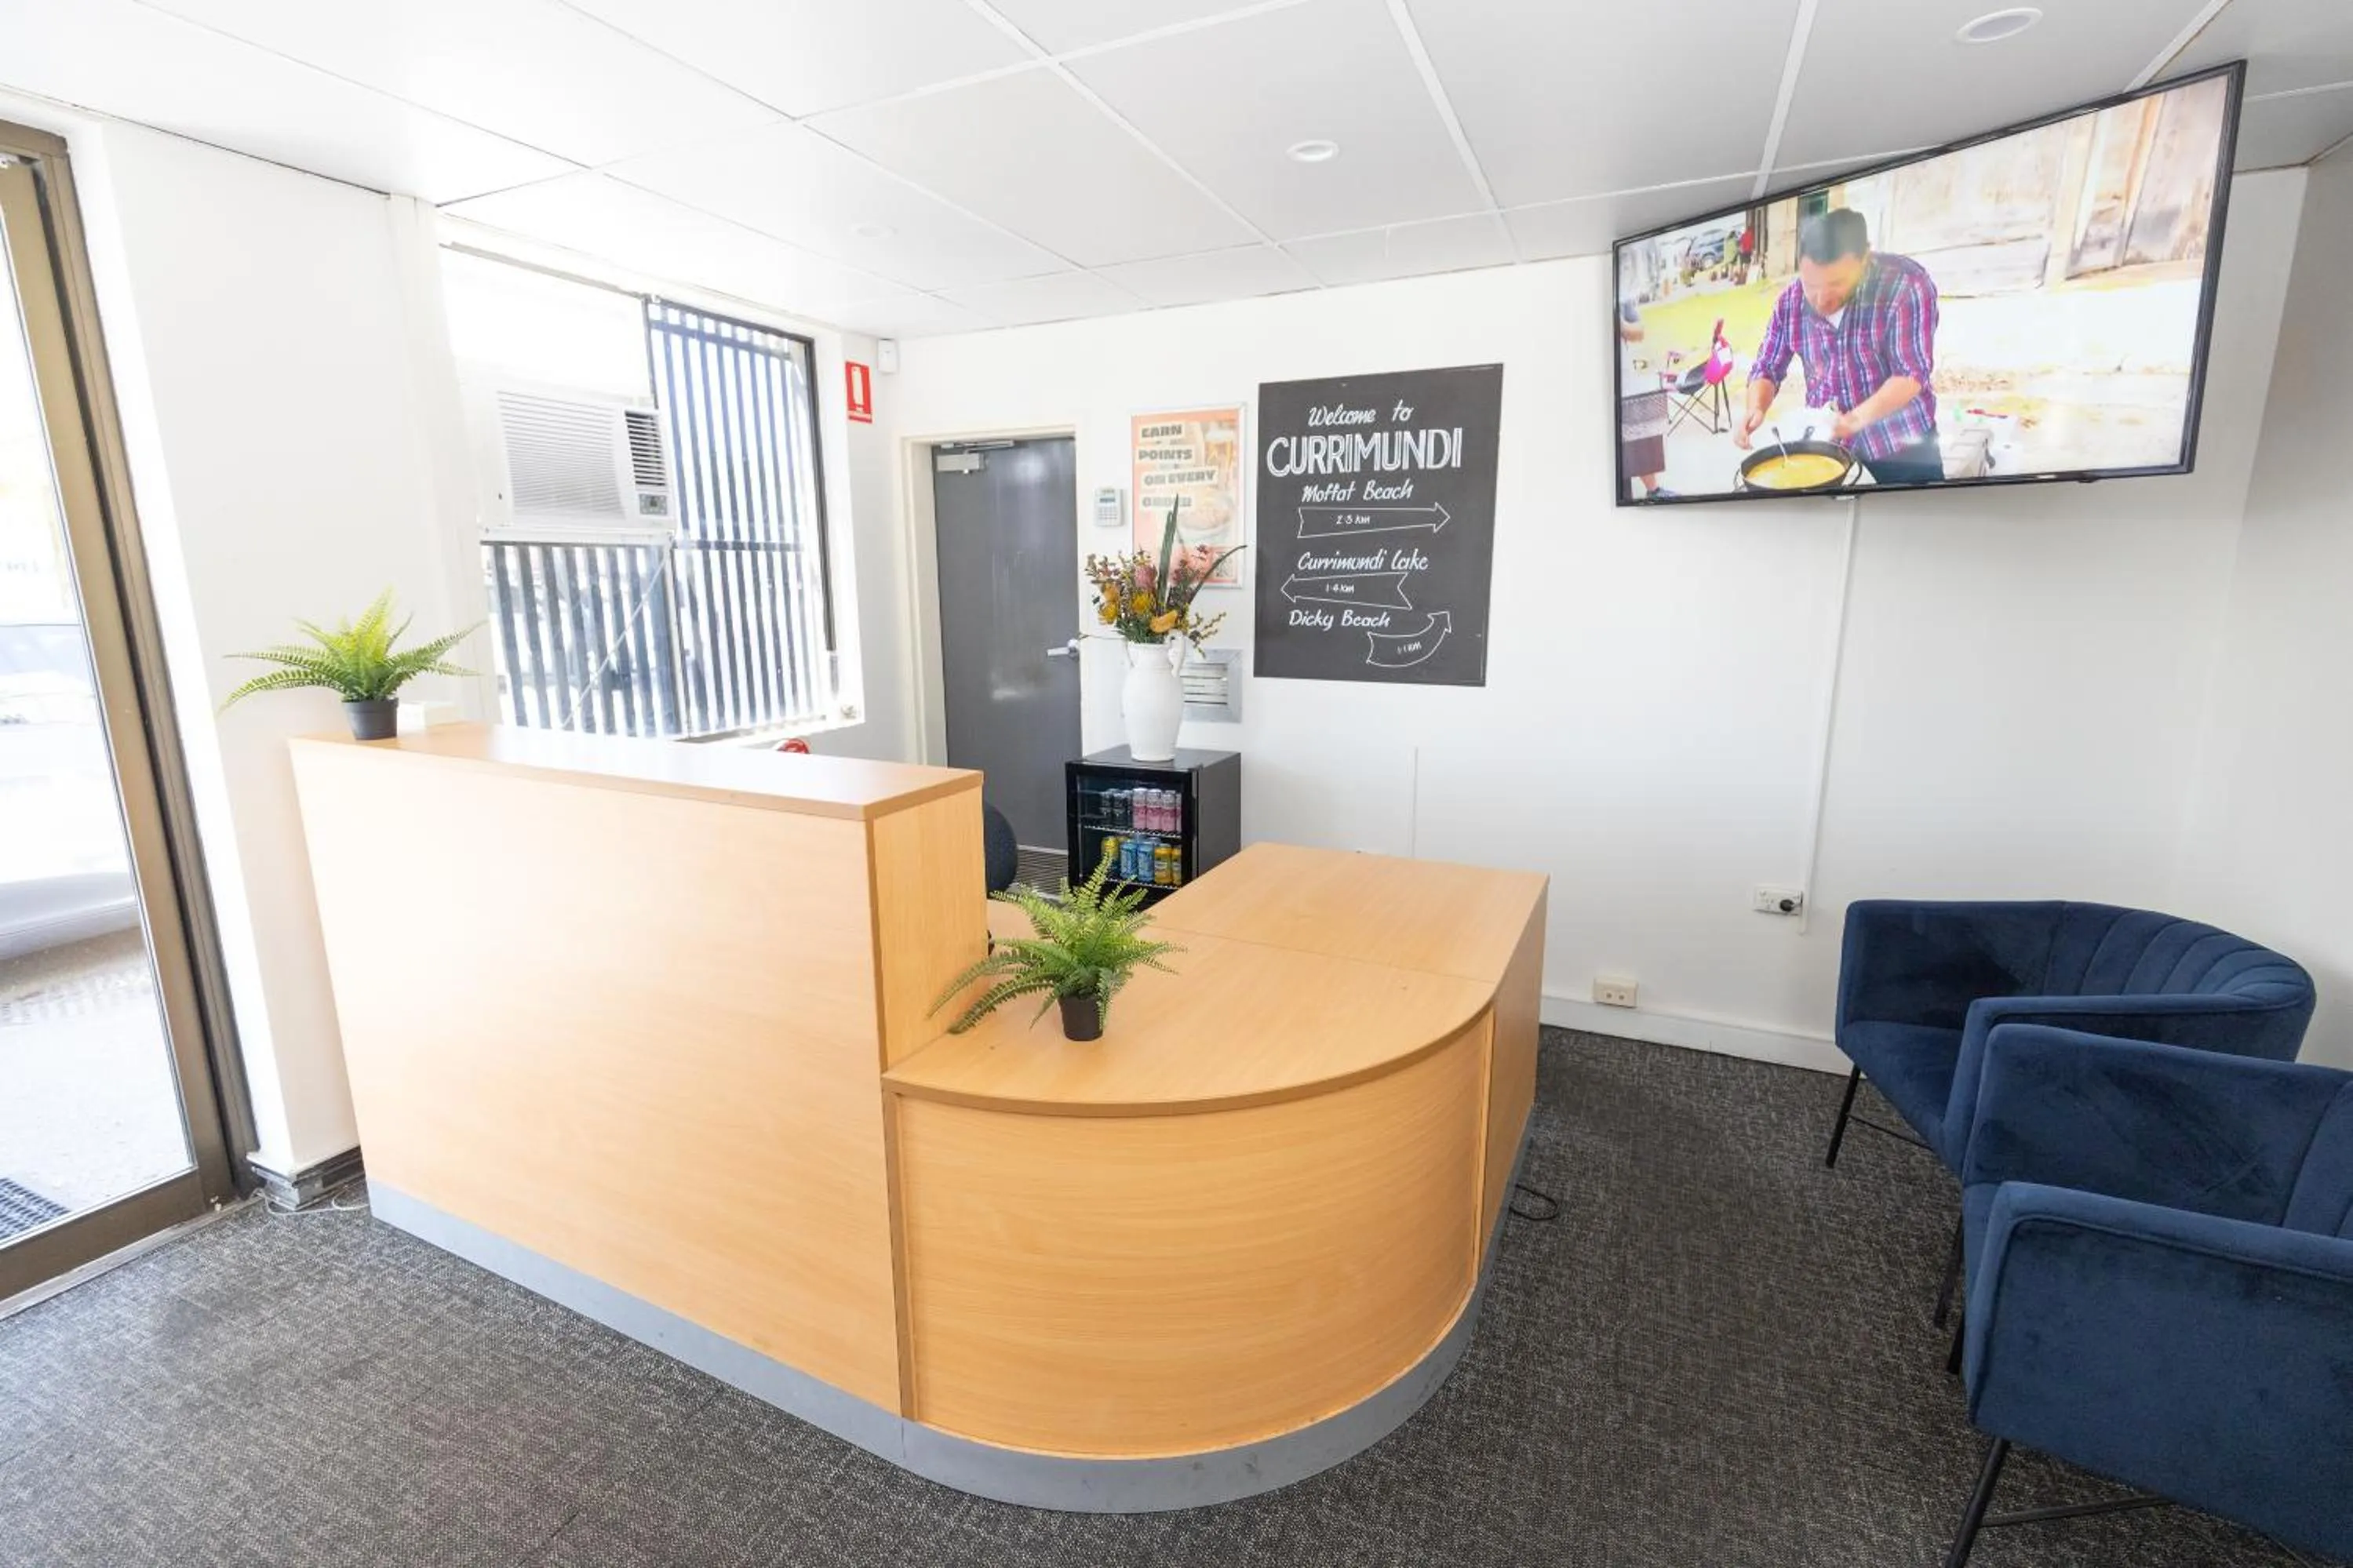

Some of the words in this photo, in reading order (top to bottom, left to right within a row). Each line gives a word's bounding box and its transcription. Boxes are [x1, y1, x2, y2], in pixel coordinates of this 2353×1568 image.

[1308, 403, 1376, 427] Welcome
[1392, 398, 1415, 422] to
[1141, 424, 1182, 438] EARN
[1138, 448, 1193, 460] POINTS
[1266, 427, 1463, 478] CURRIMUNDI
[1168, 470, 1216, 484] EVERY
[1301, 481, 1357, 503] Moffat
[1362, 478, 1414, 501] Beach
[1297, 548, 1387, 570] Currimundi
[1390, 548, 1430, 570] Lake
[1288, 609, 1333, 631] Dicky
[1341, 609, 1391, 628] Beach
